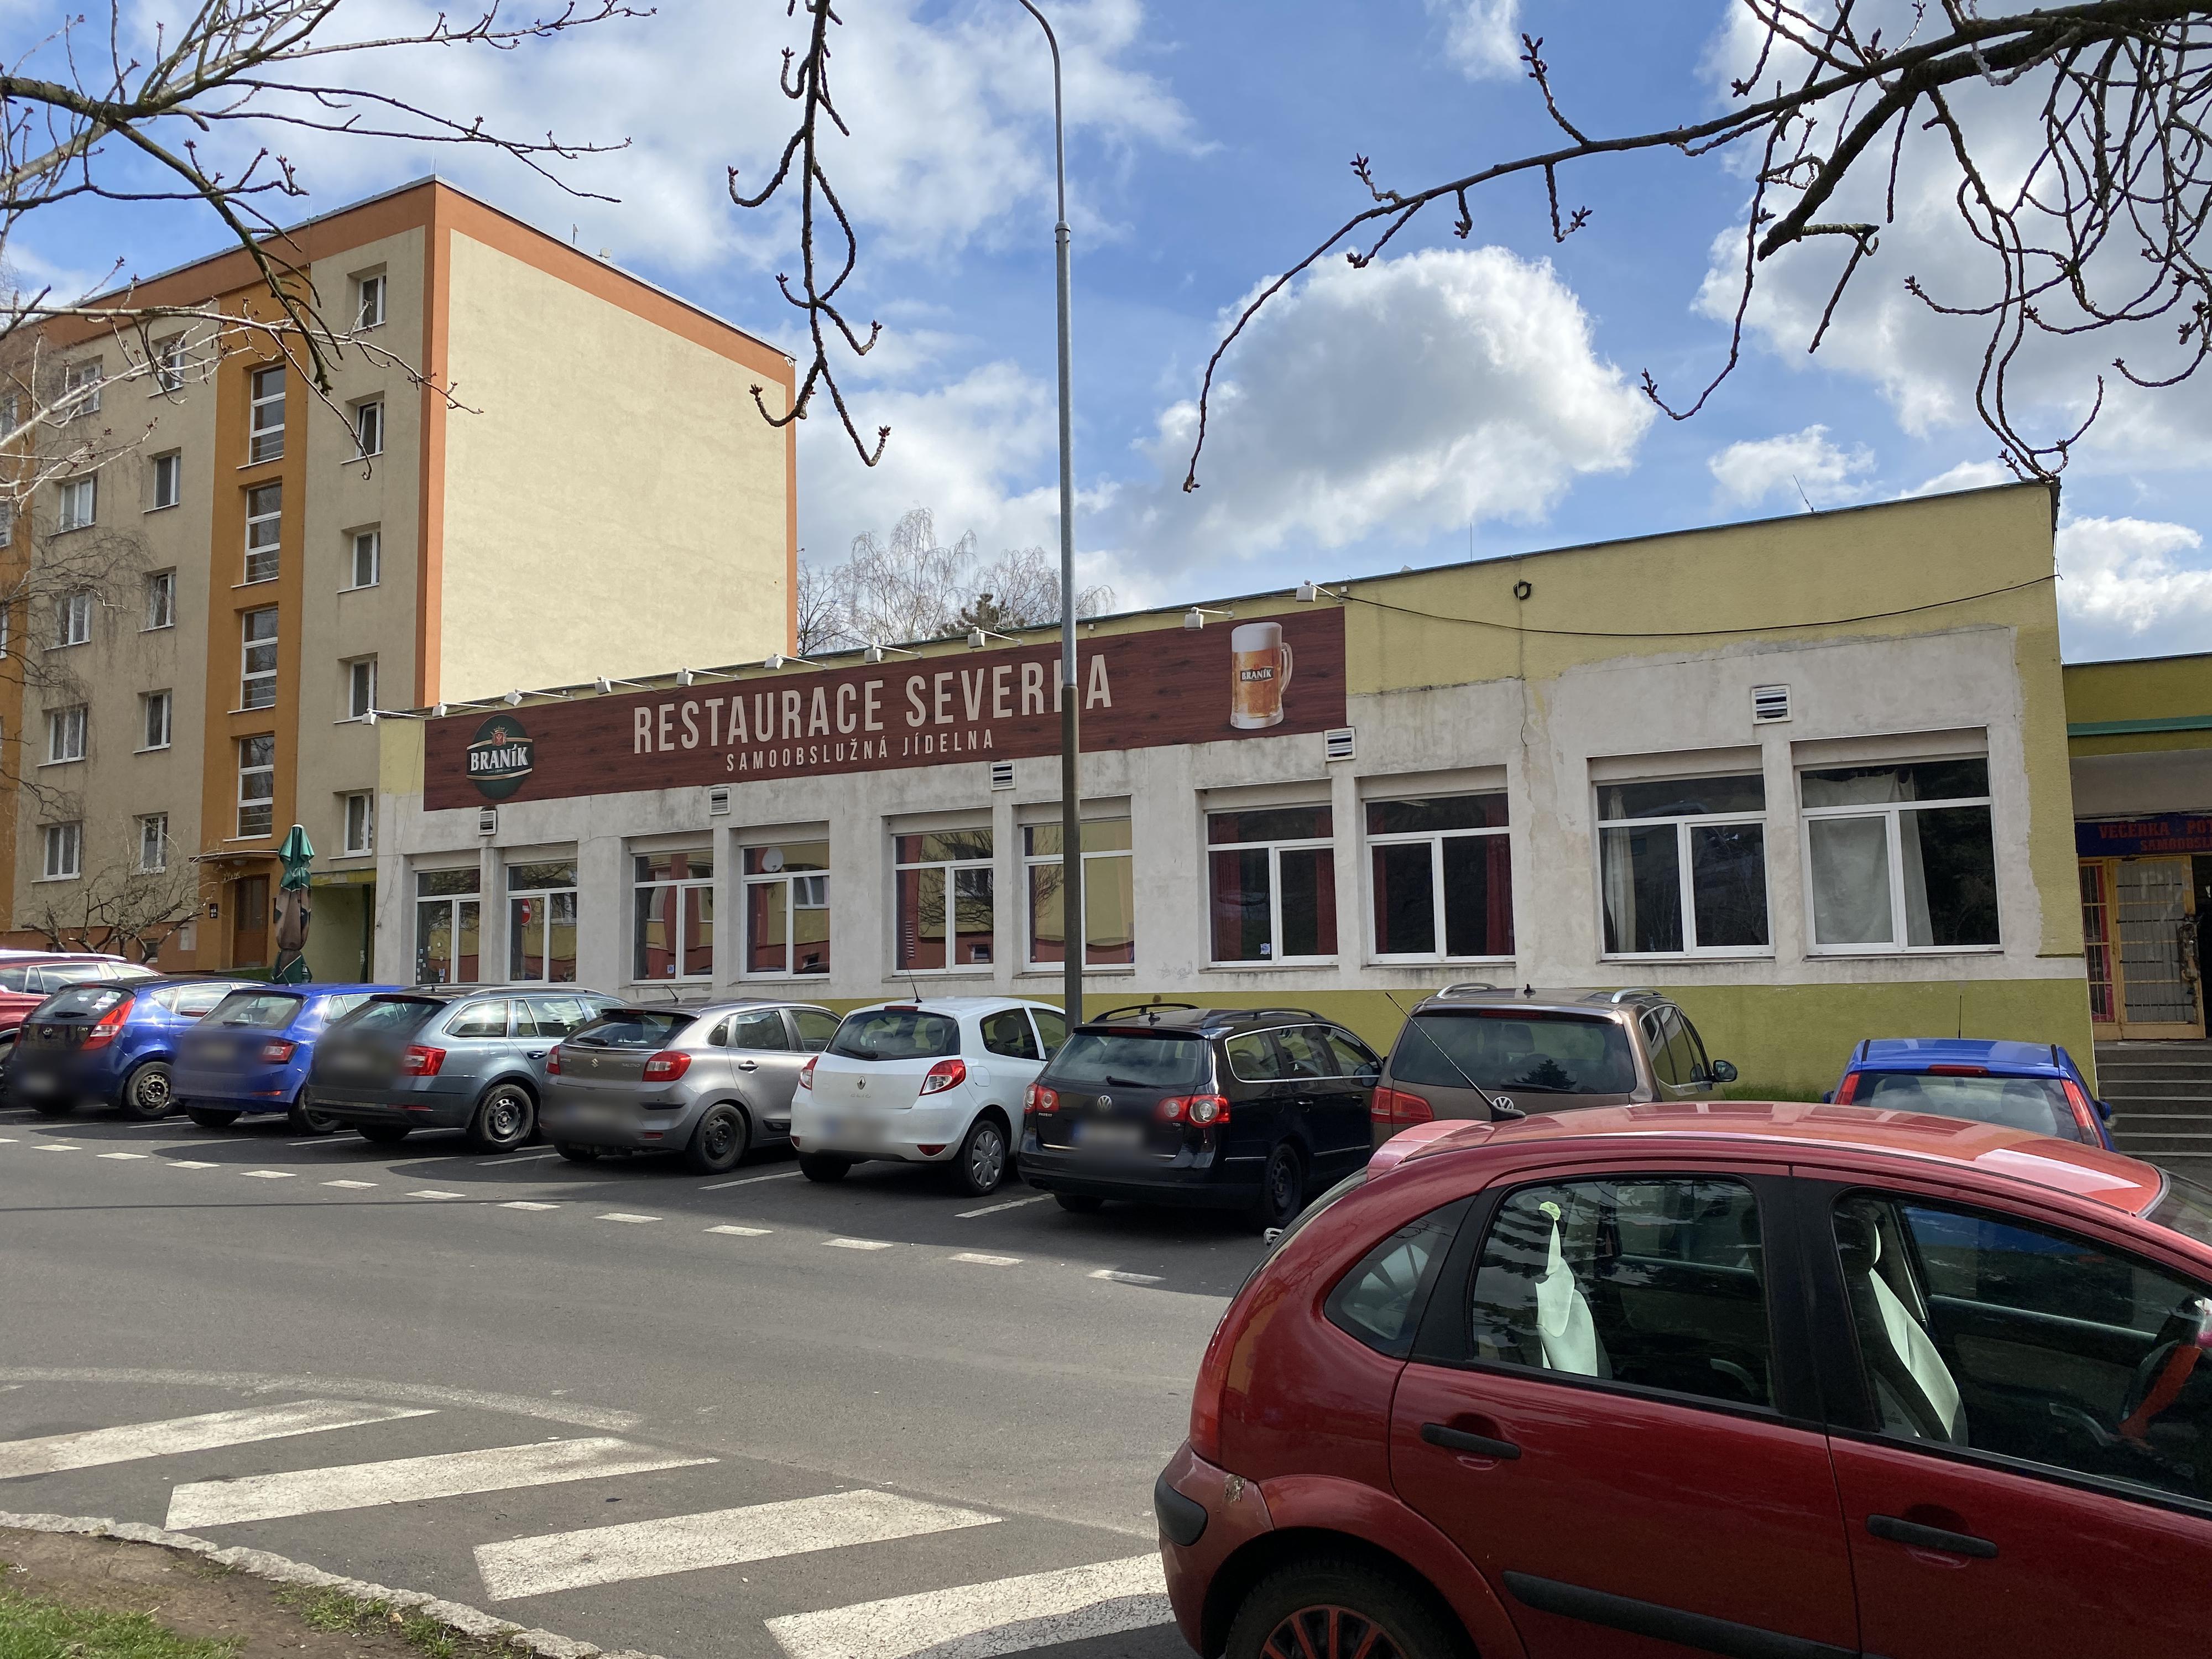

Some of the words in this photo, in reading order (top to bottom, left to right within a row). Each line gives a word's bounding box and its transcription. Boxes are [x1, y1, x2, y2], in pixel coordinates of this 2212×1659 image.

[1241, 669, 1272, 681] BRANÍK
[634, 680, 884, 754] RESTAURACE
[470, 743, 529, 771] BRANÍK
[726, 735, 888, 772] SAMOOBSLUŽNÁ
[902, 728, 993, 757] JÍDELNA
